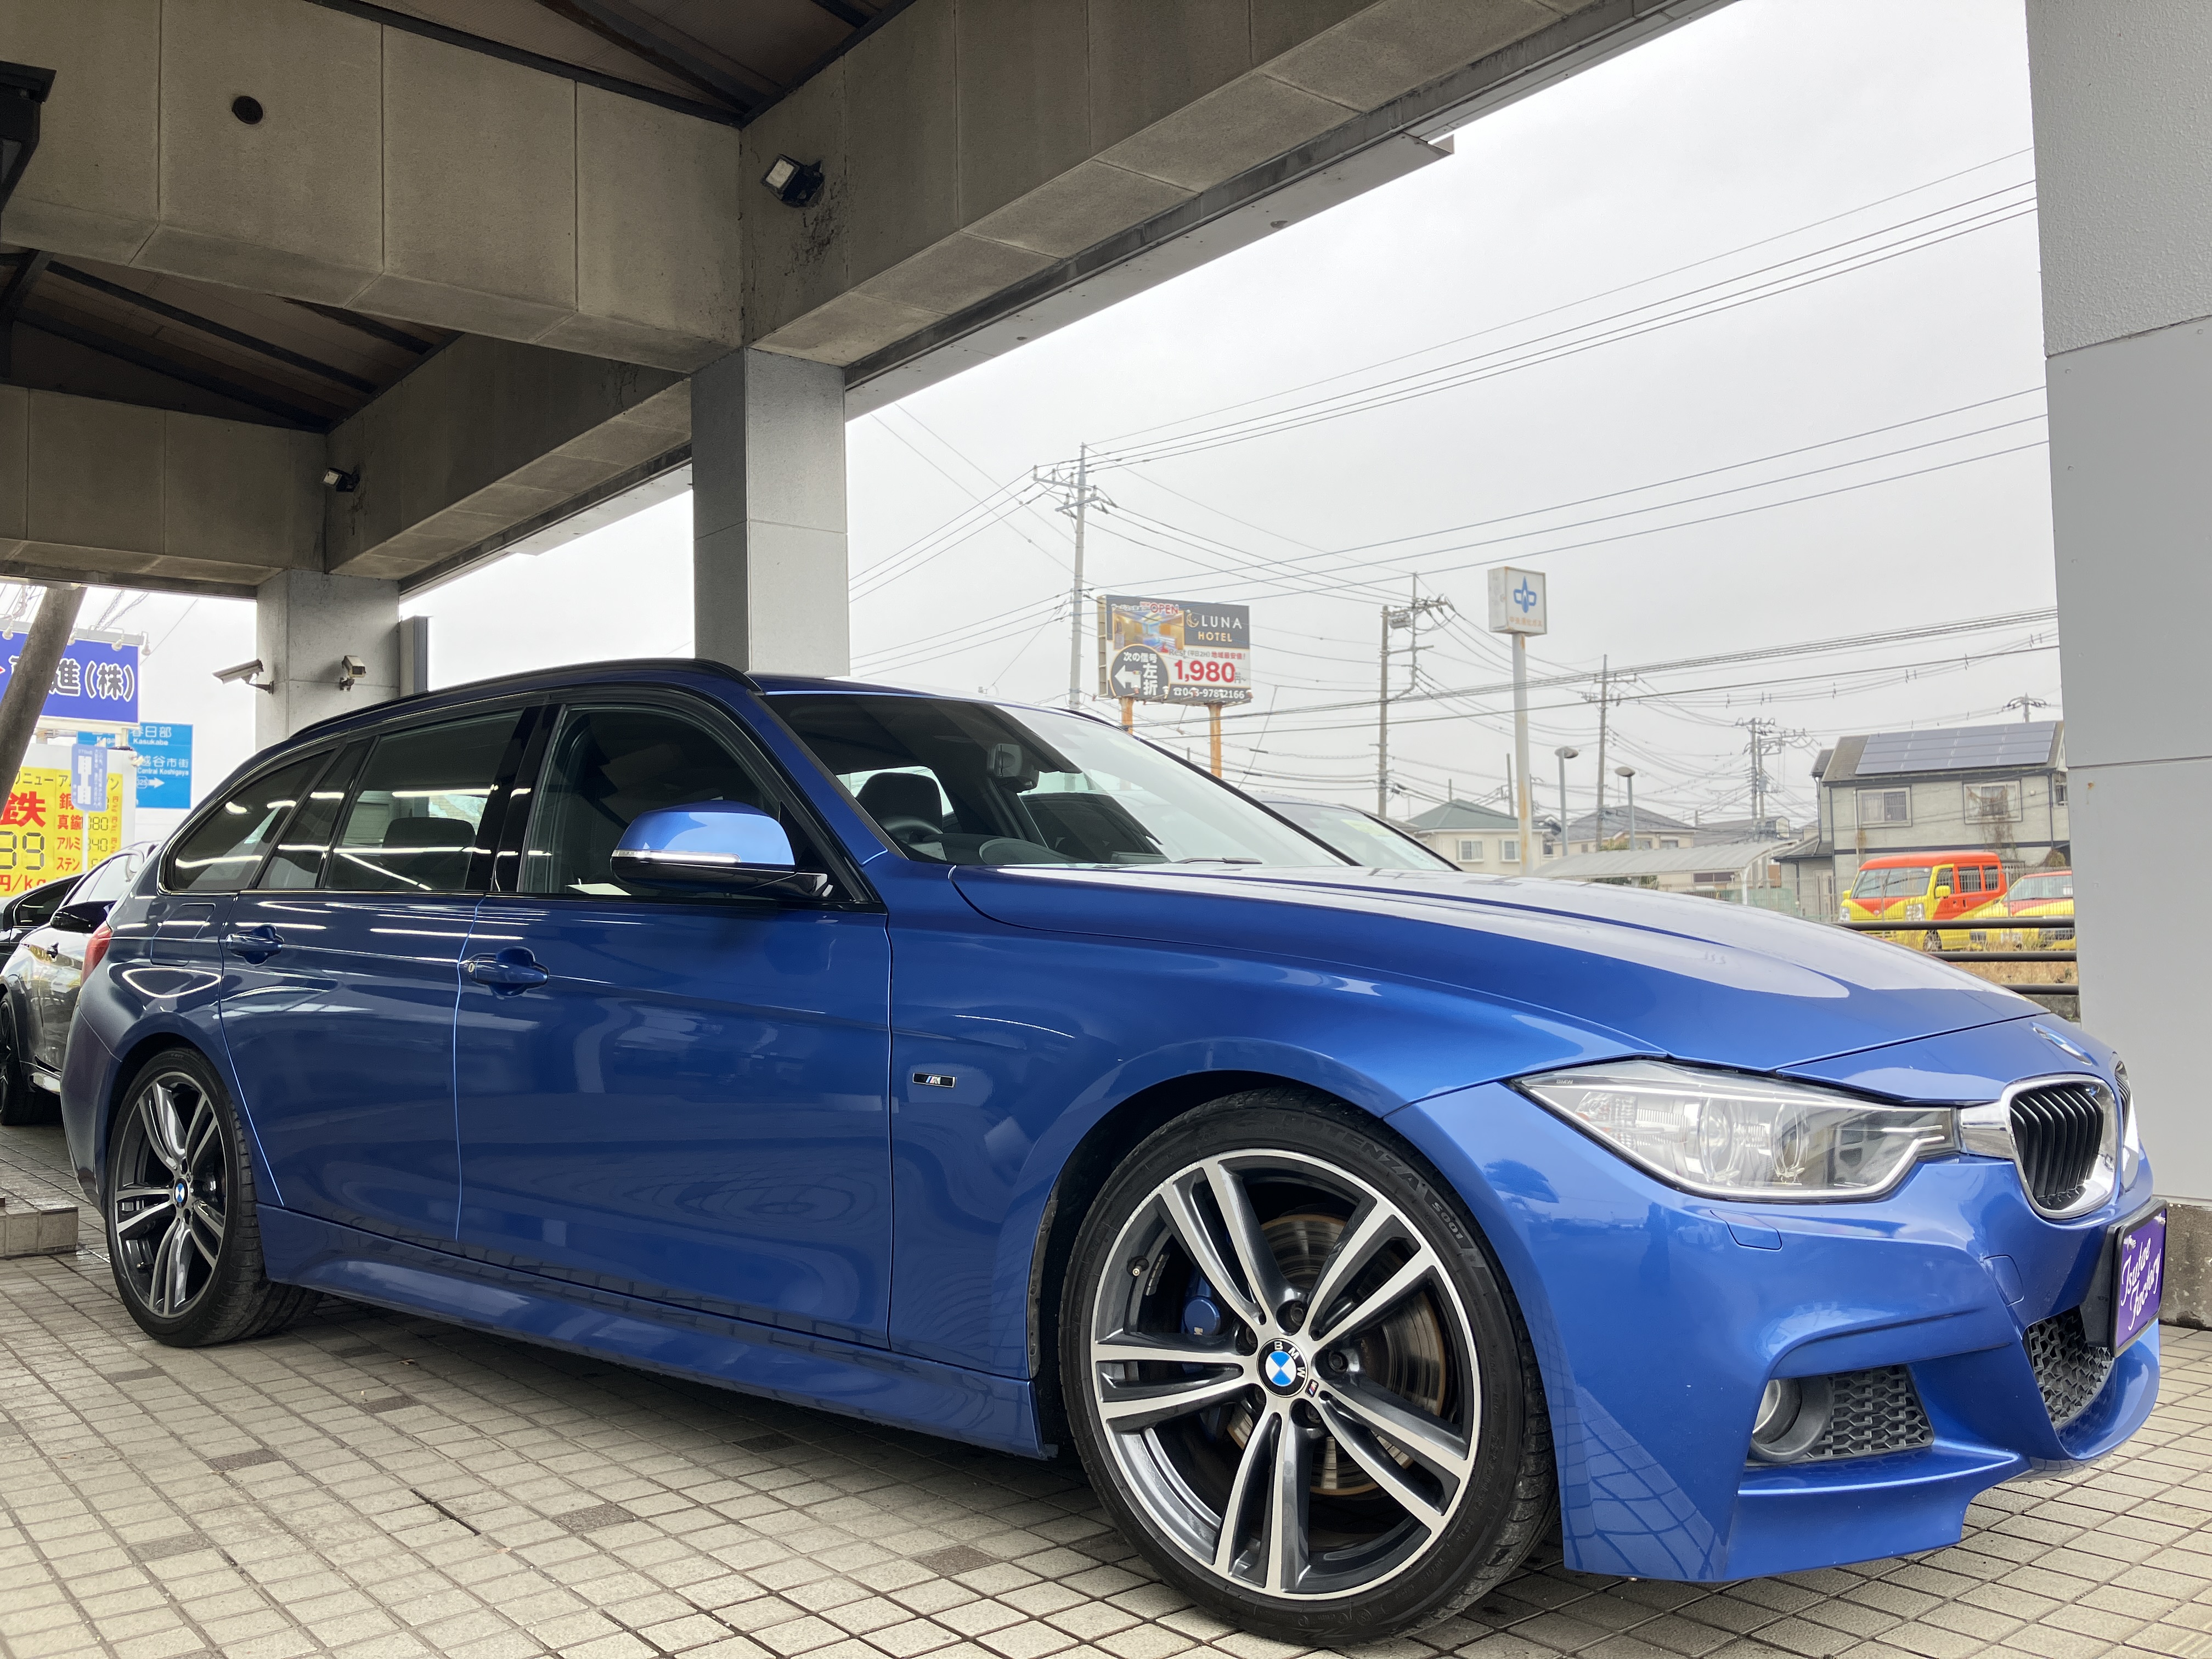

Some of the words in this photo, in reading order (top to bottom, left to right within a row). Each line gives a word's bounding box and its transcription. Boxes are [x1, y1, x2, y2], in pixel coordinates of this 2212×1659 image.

[1150, 603, 1178, 614] OPEN
[1201, 615, 1242, 629] LUNA
[1198, 631, 1232, 642] HOTEL
[1123, 652, 1158, 663] 次の信号
[1175, 659, 1235, 683] 1,980
[1143, 663, 1158, 696] 左折
[132, 725, 172, 738] 春日部
[133, 737, 168, 746] Kasukabe
[160, 768, 189, 777] Koshigaya
[57, 837, 81, 851] アルミ
[57, 857, 80, 872] ステン
[1431, 1201, 1464, 1240] S001
[1274, 1341, 1306, 1379] BMW
